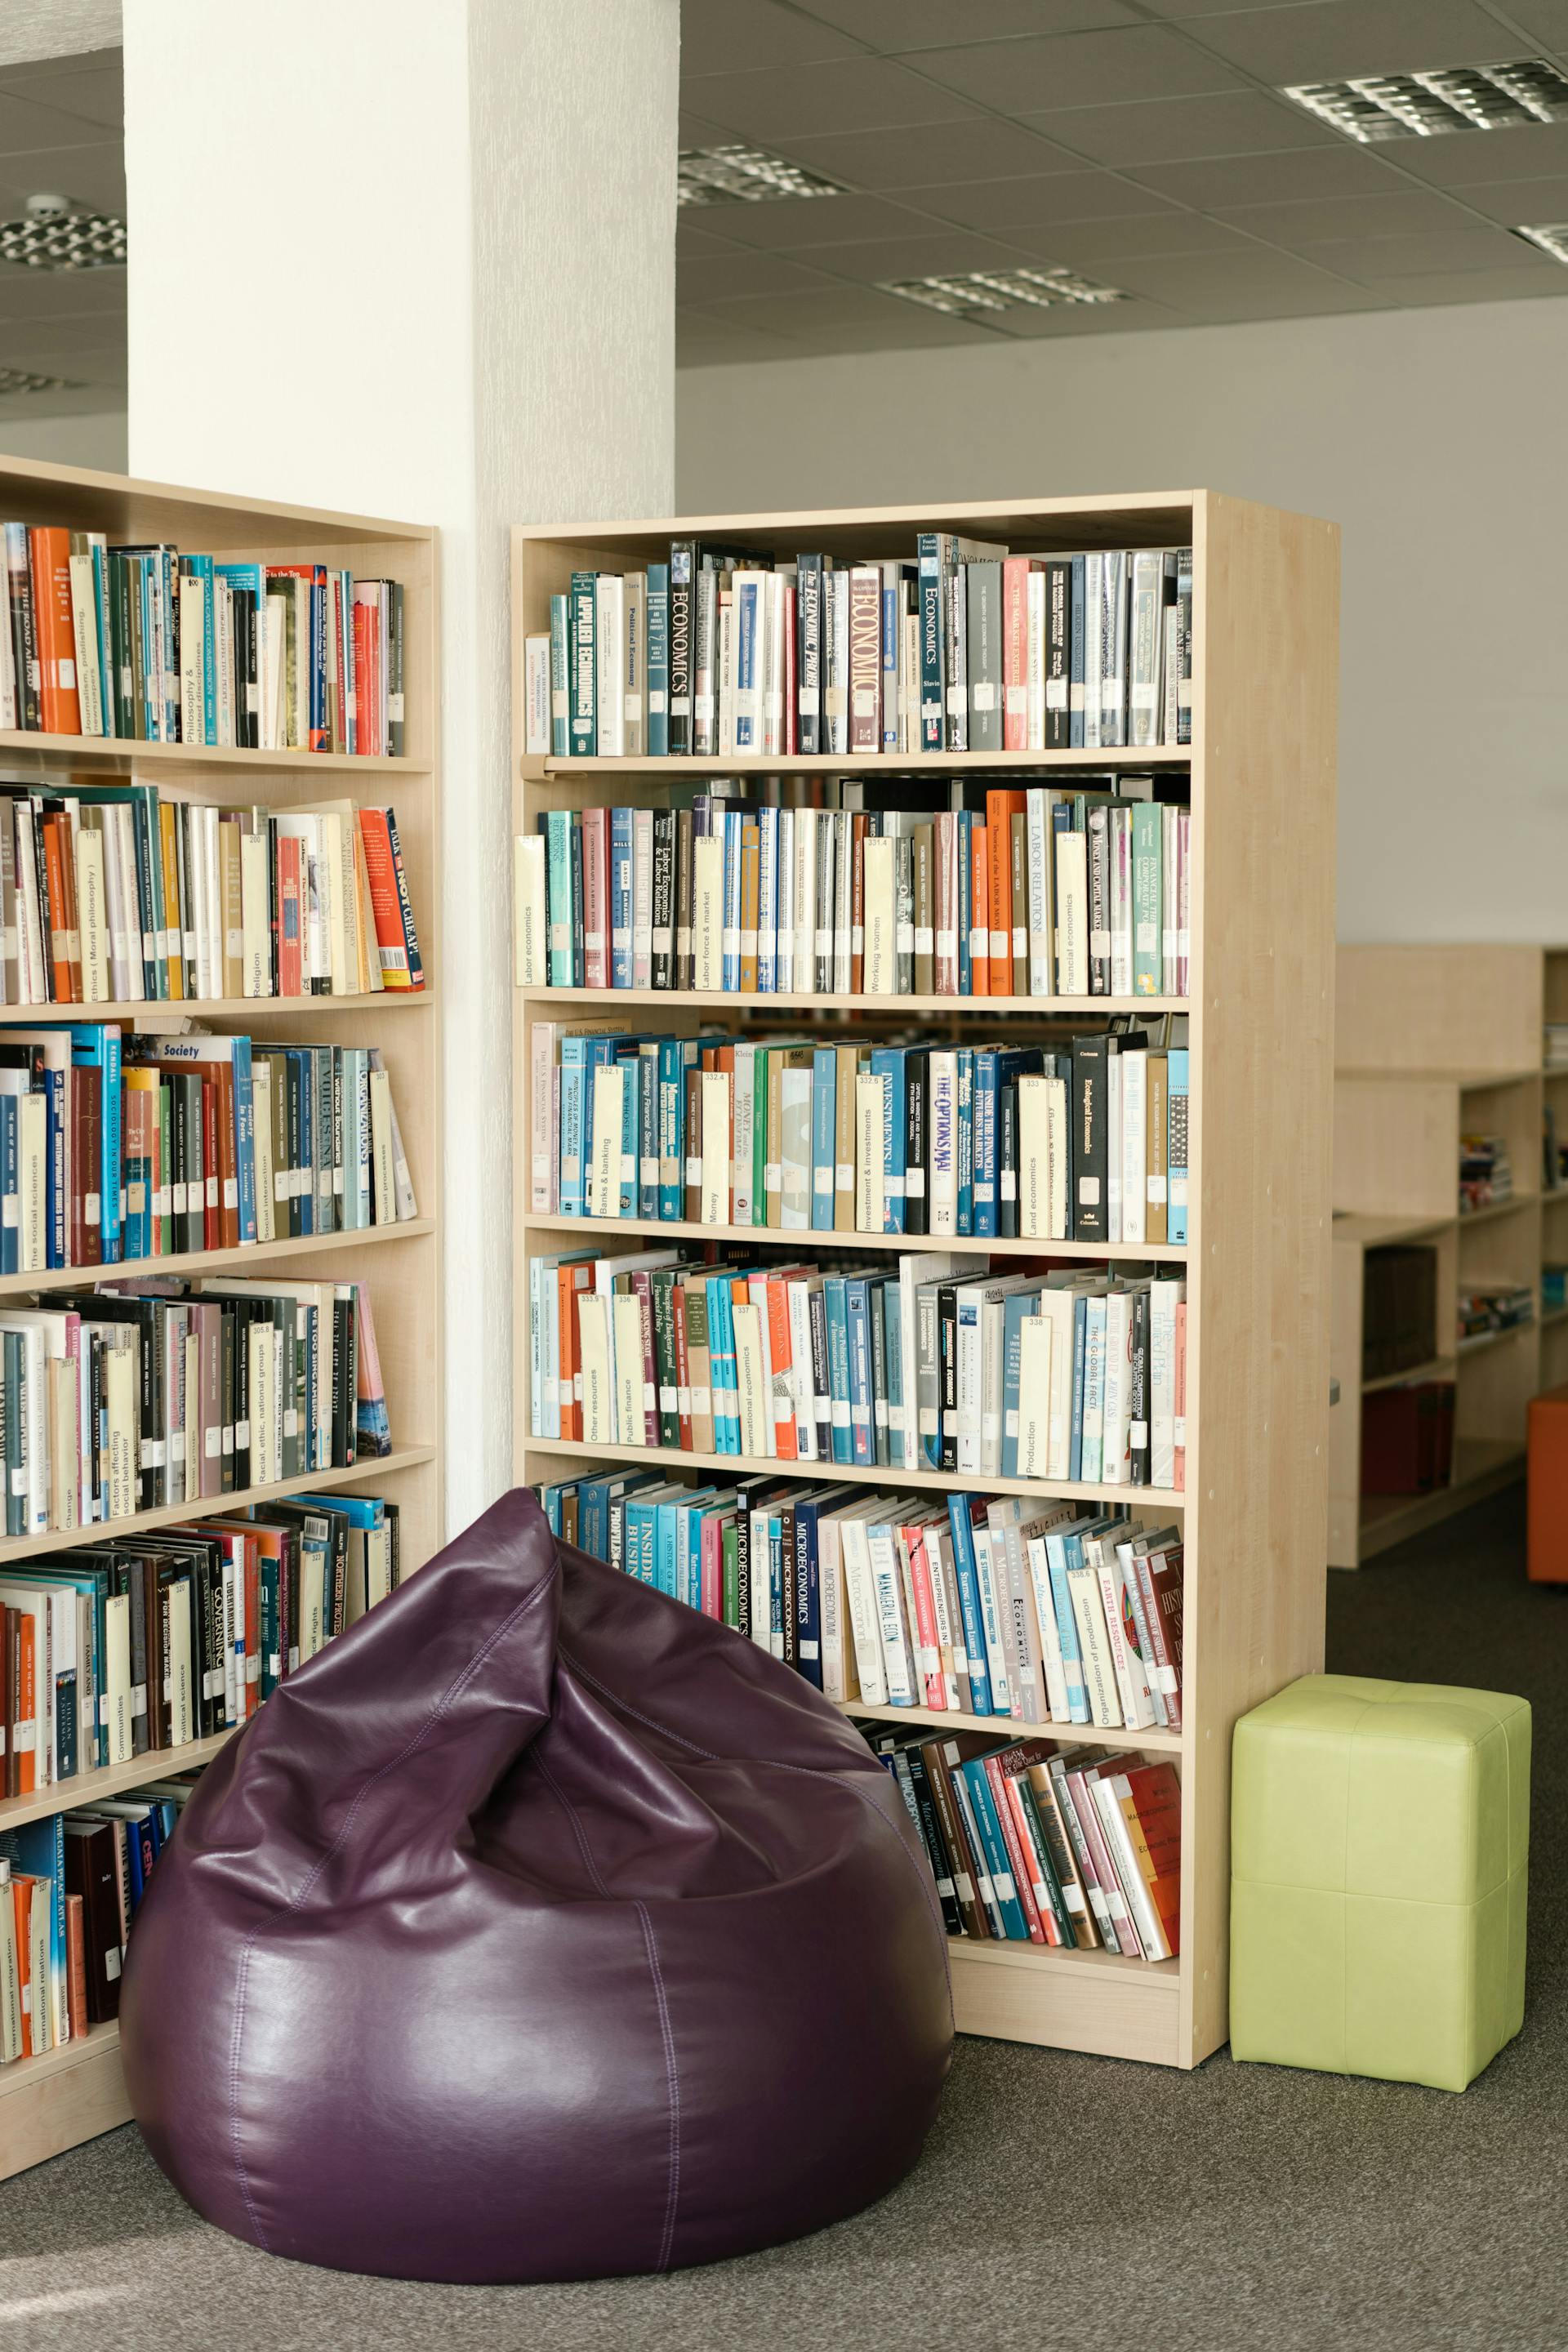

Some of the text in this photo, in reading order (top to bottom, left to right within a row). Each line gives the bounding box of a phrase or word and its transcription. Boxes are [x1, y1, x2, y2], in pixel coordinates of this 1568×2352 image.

[22, 587, 30, 610] THE
[573, 621, 577, 630] AN
[578, 596, 593, 643] APPLIED
[806, 571, 818, 649] The ECONOMIC
[925, 588, 937, 664] ECONOMICS
[23, 613, 31, 645] ROAD
[78, 608, 88, 666] publishing,
[672, 592, 688, 693] ECONOMICS
[578, 647, 593, 716] ECONOMICS
[186, 680, 194, 742] Philosophy
[390, 827, 401, 854] TALK
[993, 855, 999, 863] of
[88, 871, 98, 929] philosophy
[397, 870, 418, 954] NOT CHEAP!
[662, 848, 670, 921] Labor Economics
[871, 954, 881, 992] Working
[165, 1045, 199, 1058] Society
[935, 1076, 951, 1147] THE OPTIONS
[1083, 1080, 1092, 1115] Ecological
[112, 1147, 117, 1157] IN
[601, 1138, 612, 1174] banking
[975, 1090, 983, 1169] FUTURES MARKETS
[984, 1090, 993, 1179] INSIDE THE FINANCIAL
[56, 1215, 63, 1223] IN
[56, 1226, 64, 1254] SOCIETY
[115, 1350, 127, 1358] 304
[257, 1344, 266, 1379] groups
[745, 1398, 754, 1455] International
[1027, 1422, 1036, 1472] Production
[112, 1431, 121, 1481] affecting
[642, 1521, 653, 1582] INSIDE
[738, 1523, 747, 1634] MICROECONOMICS
[796, 1522, 808, 1624] MICROECONOMICS
[114, 1599, 123, 1608] 307
[176, 1584, 185, 1592] 320
[226, 1581, 234, 1649] LIBERTARIANISM
[785, 1555, 793, 1659] MICROECONOMICS
[981, 1562, 991, 1597] STRUCTURE
[987, 1607, 996, 1644] PRODUCTION
[996, 1557, 1013, 1650] MICROECONOMICS
[215, 1587, 225, 1667] GOVERNING
[1080, 1598, 1110, 1725] Organization of production
[1058, 1782, 1089, 1864] Dollars, Debts, and Deficits
